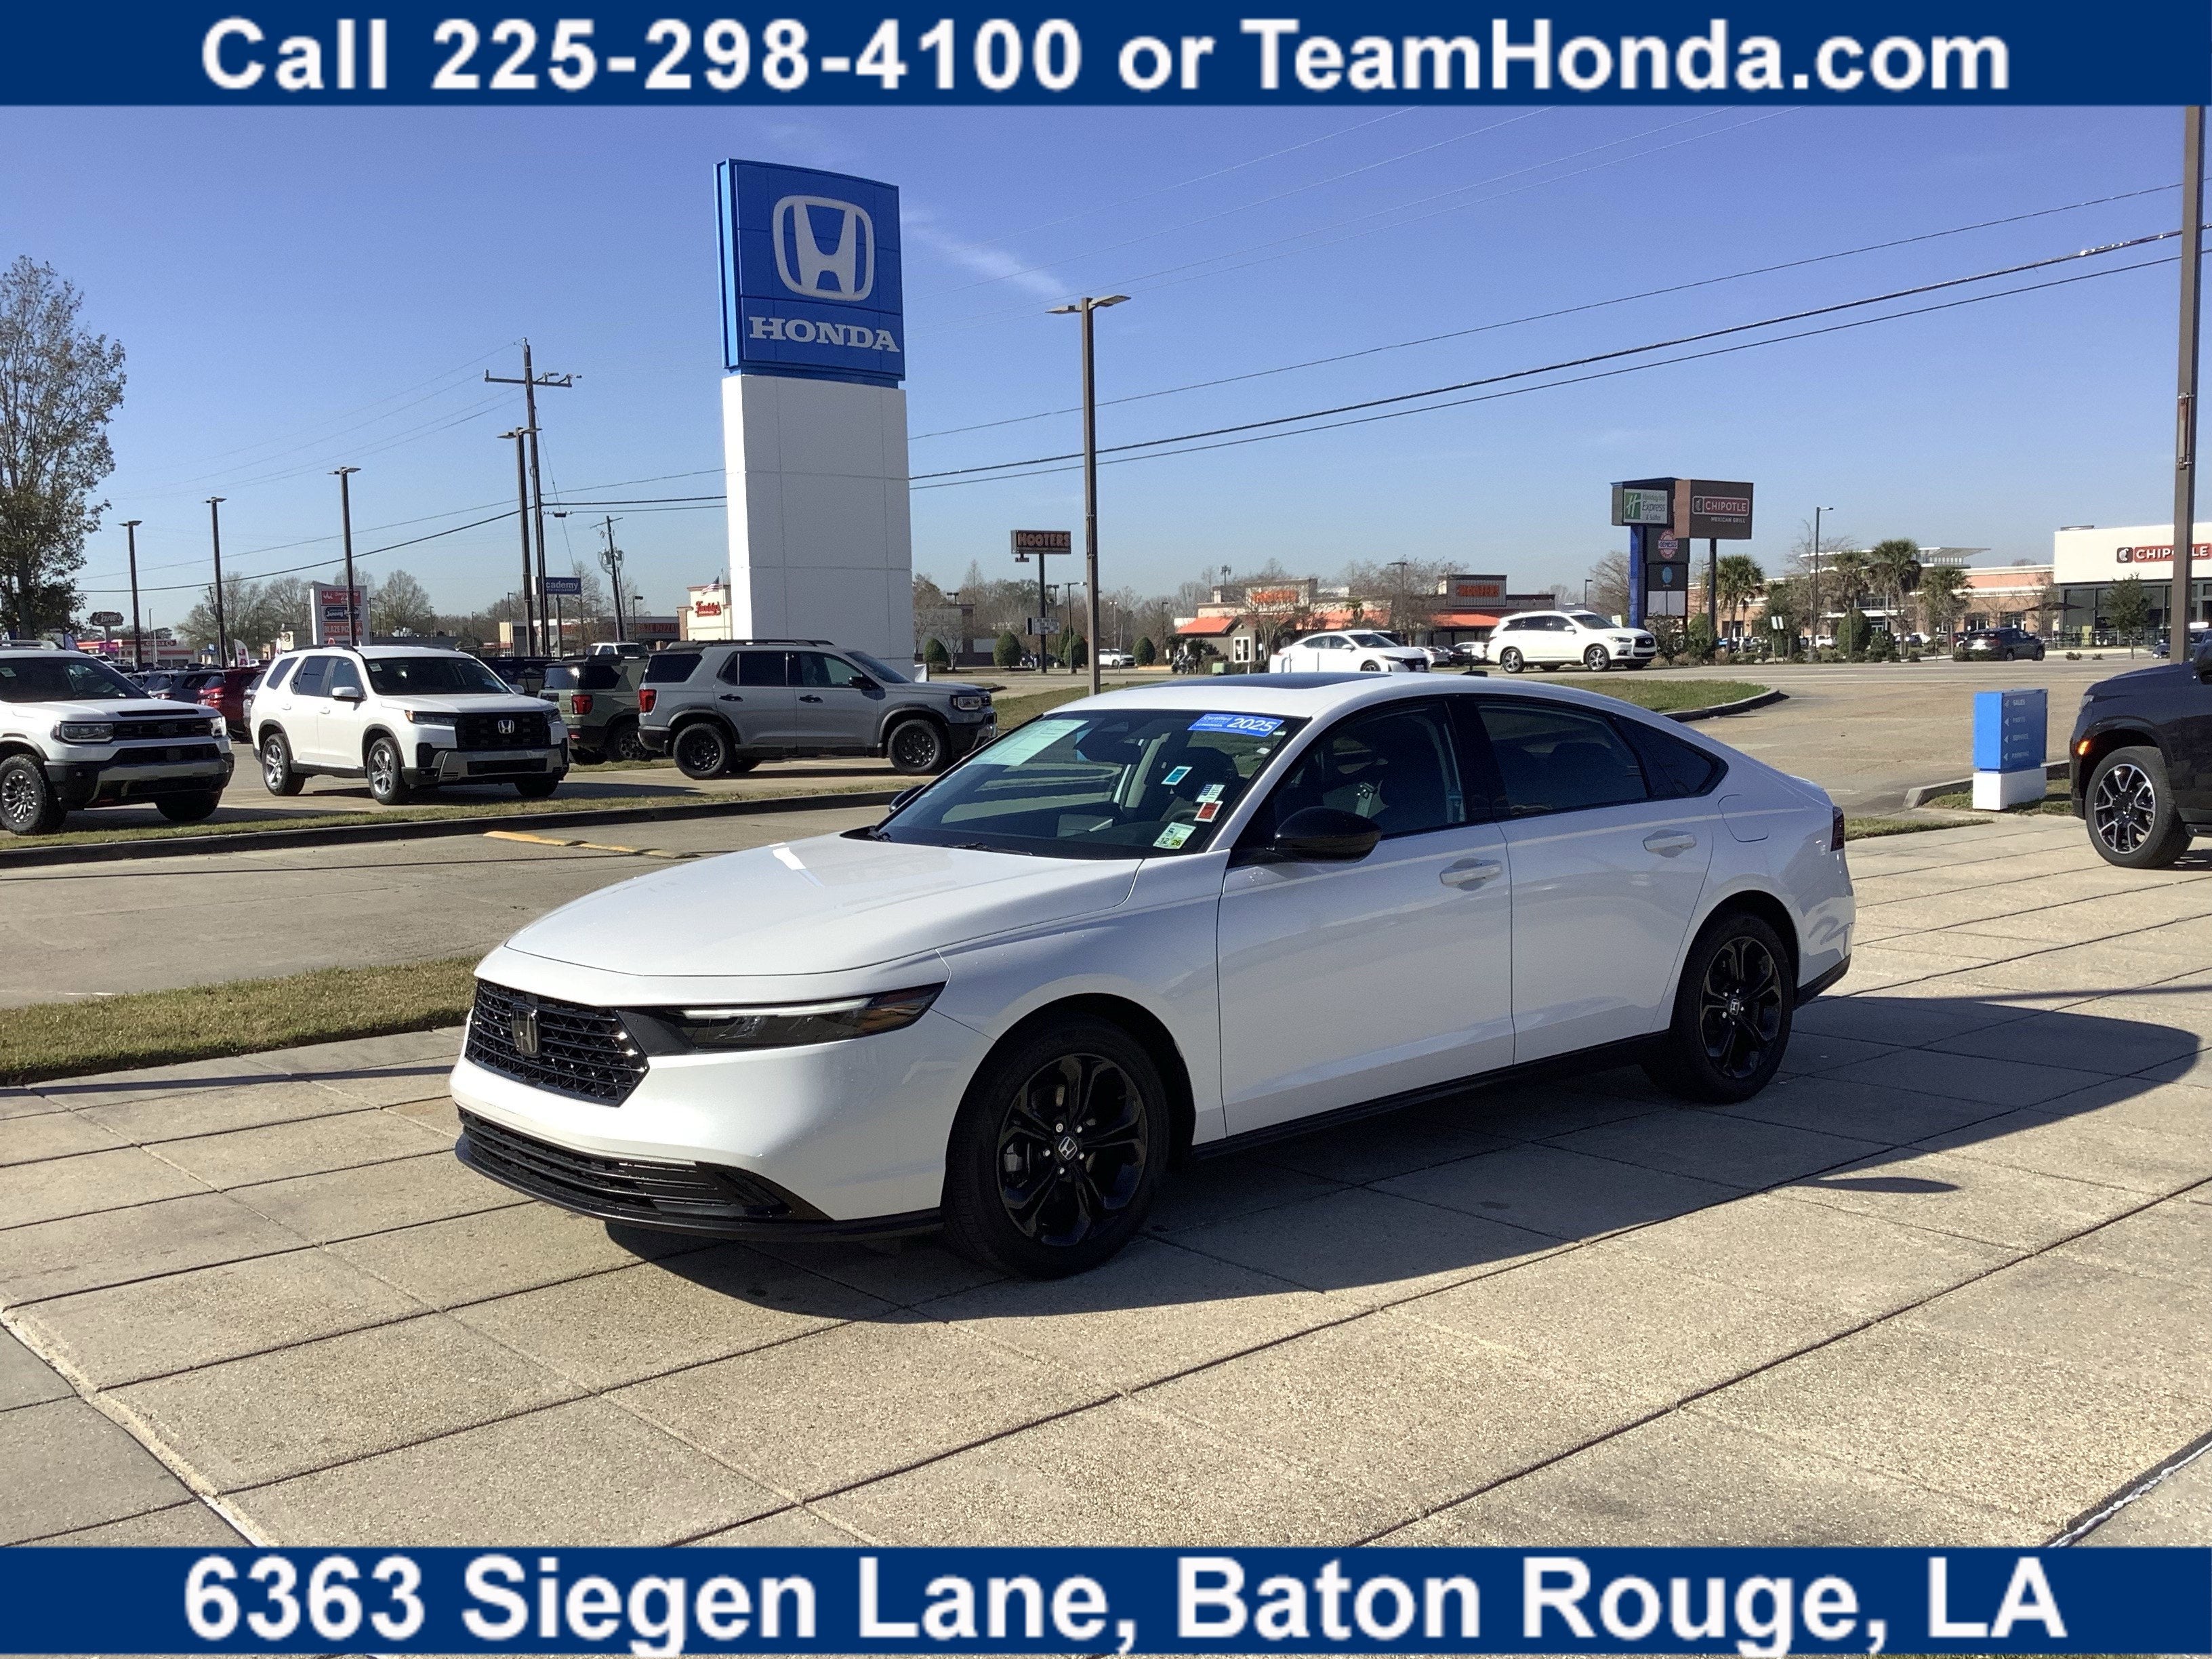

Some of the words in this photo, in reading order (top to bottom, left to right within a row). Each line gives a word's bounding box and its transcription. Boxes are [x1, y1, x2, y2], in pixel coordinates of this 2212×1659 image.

[749, 316, 900, 352] HONDA
[1642, 501, 1666, 513] Express
[1705, 501, 1746, 512] CHIPOTLE
[1017, 533, 1070, 547] HOOTERS
[2135, 546, 2209, 560] CHIPLE
[546, 581, 579, 590] cademy
[1227, 718, 1277, 732] 2025
